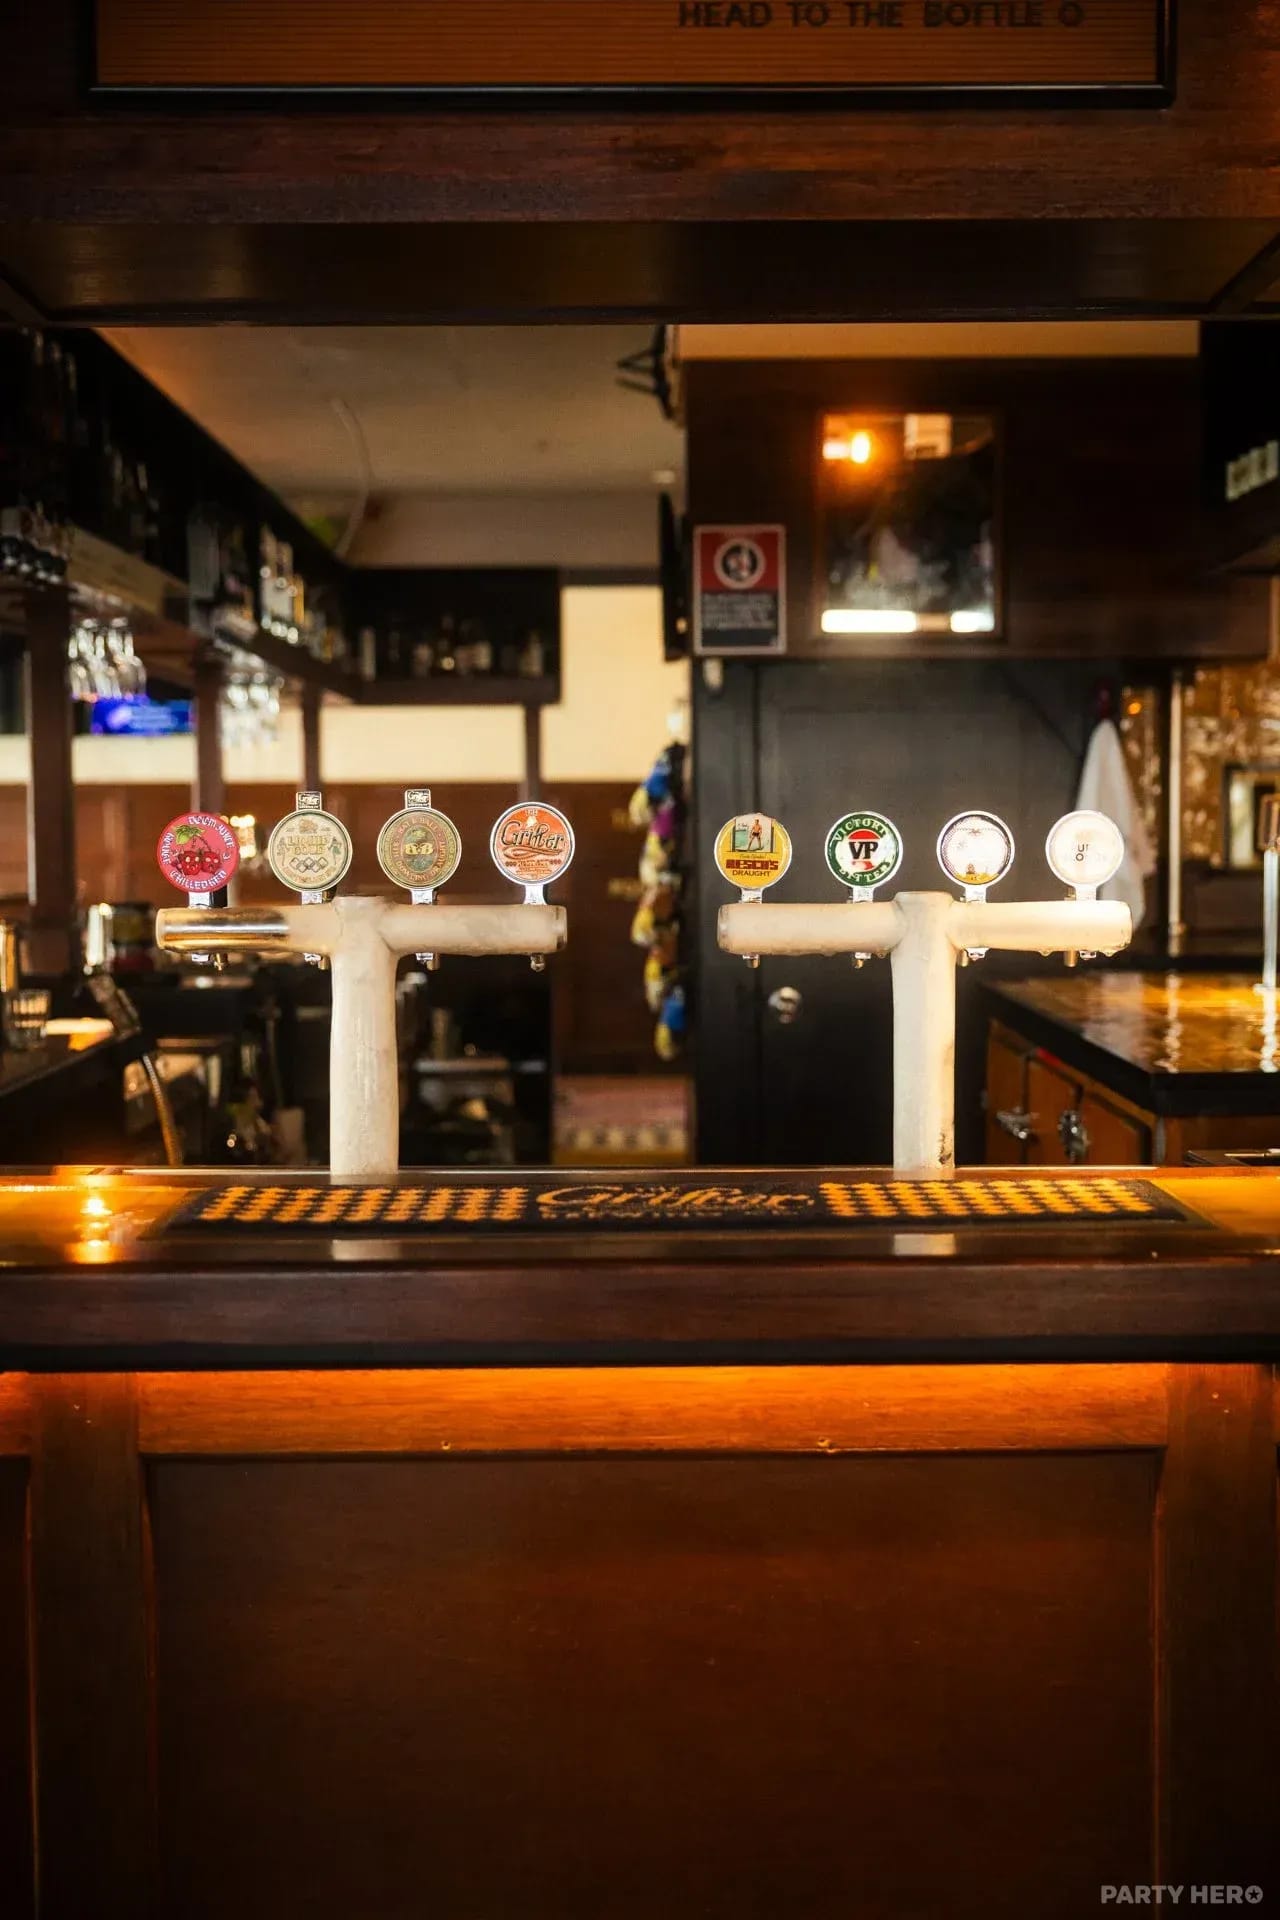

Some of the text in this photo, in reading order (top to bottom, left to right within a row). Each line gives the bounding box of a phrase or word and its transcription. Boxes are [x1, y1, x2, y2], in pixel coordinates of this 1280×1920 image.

[679, 1, 770, 28] HEAD
[789, 1, 830, 28] TO
[845, 1, 903, 28] THE
[923, 1, 1043, 28] BOTTLE
[501, 820, 565, 849] Grifter
[833, 817, 887, 842] VICTORY
[848, 841, 878, 860] VP
[732, 870, 771, 878] DRAUGHT
[838, 861, 891, 883] BITTER
